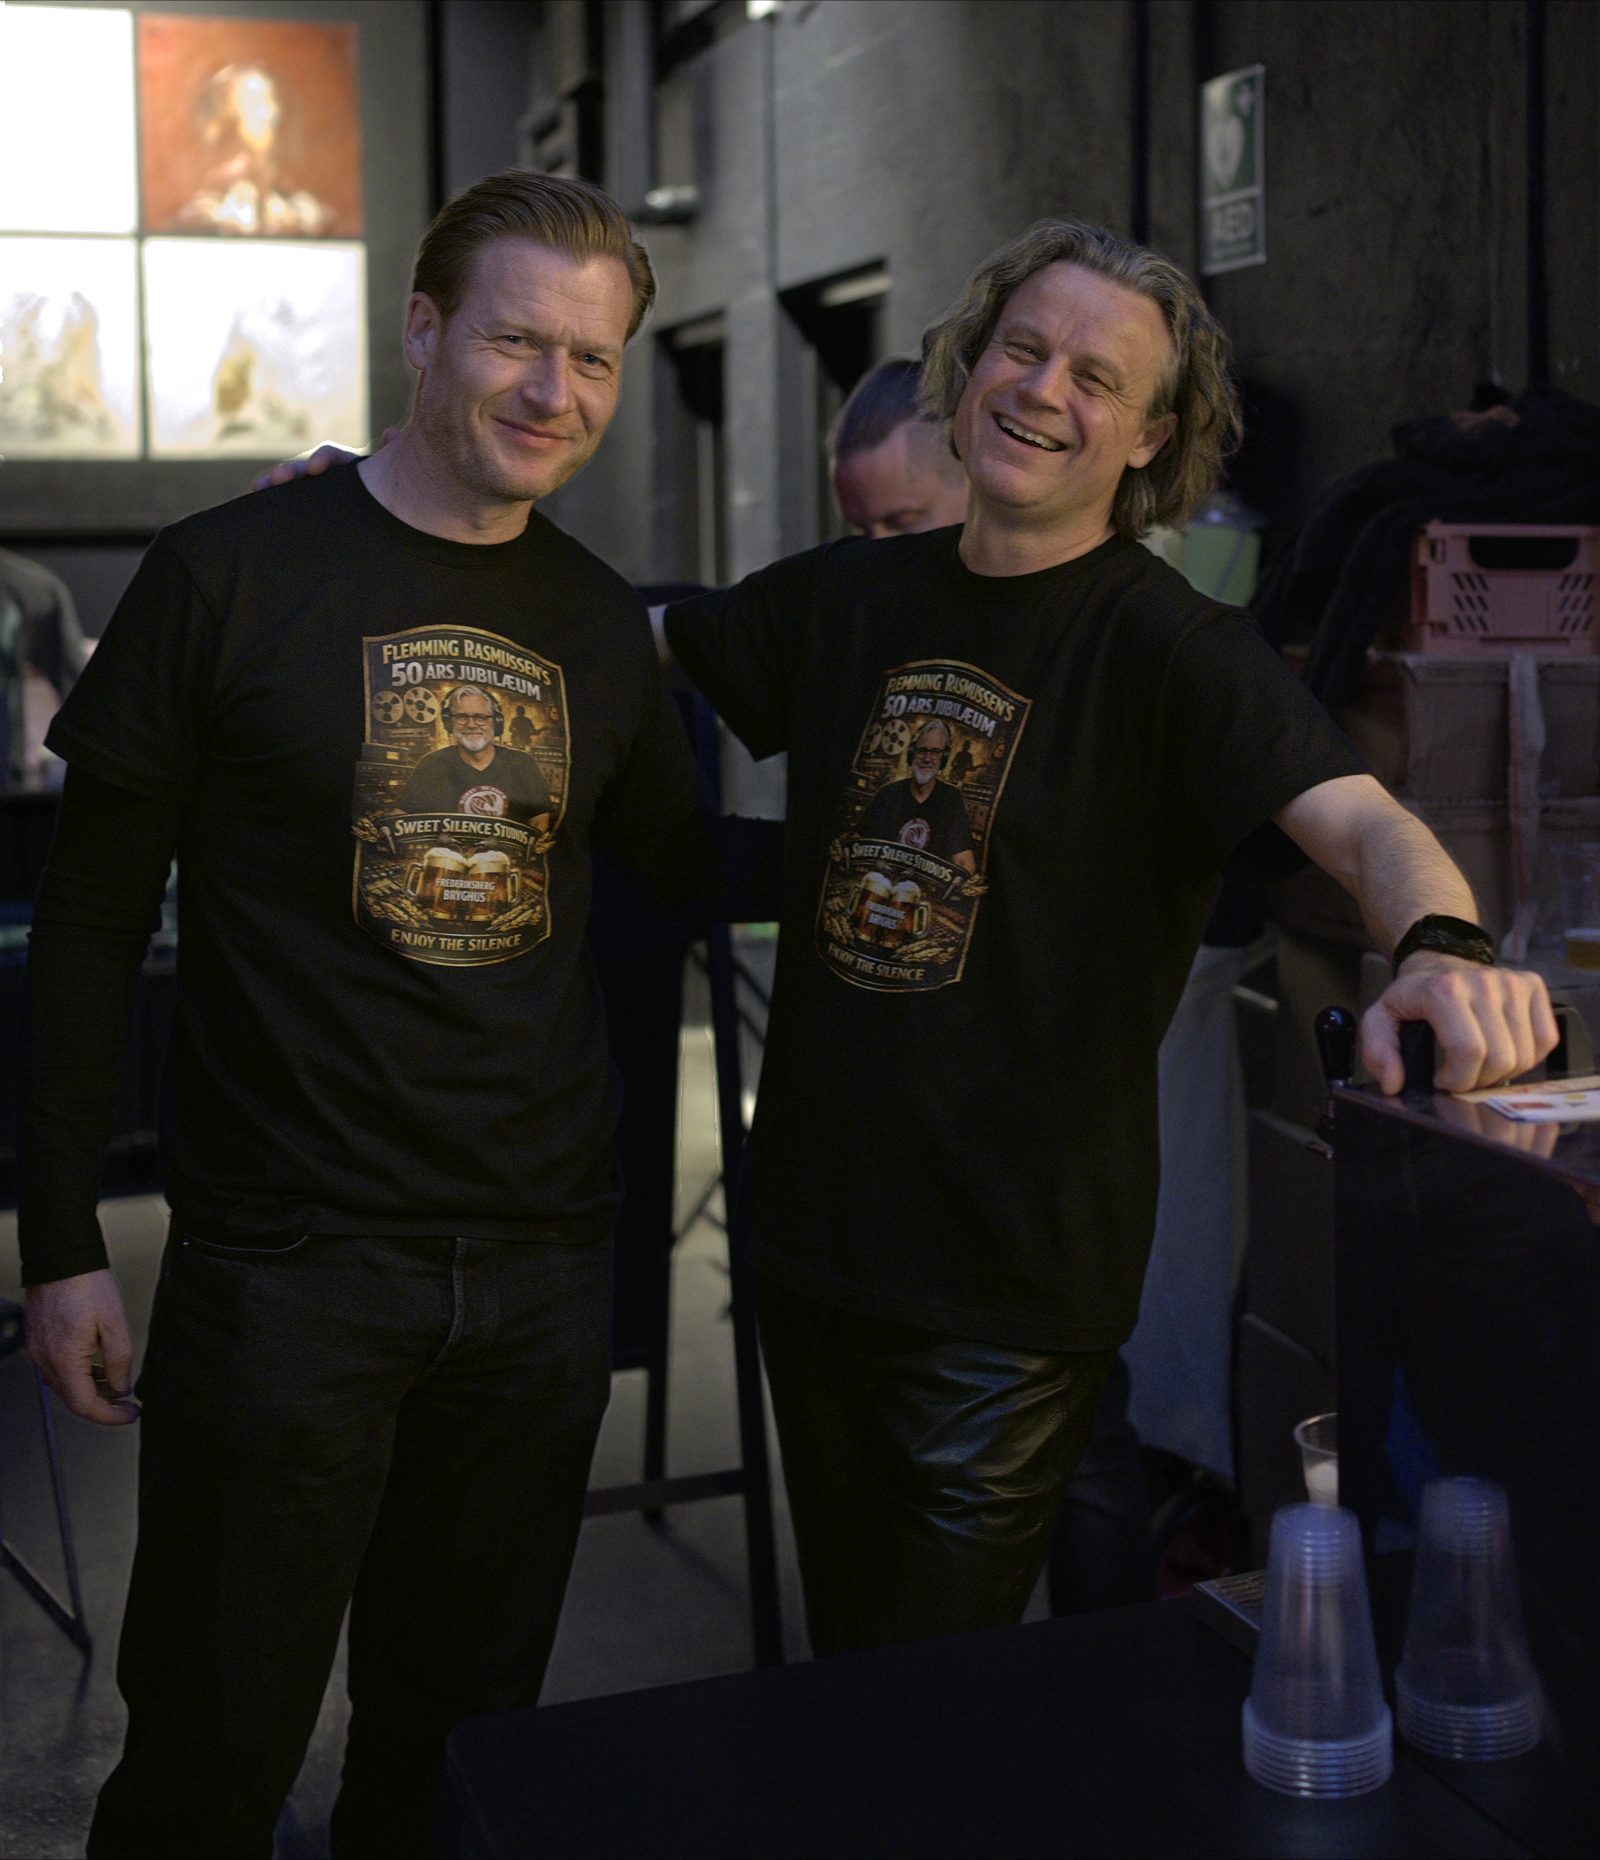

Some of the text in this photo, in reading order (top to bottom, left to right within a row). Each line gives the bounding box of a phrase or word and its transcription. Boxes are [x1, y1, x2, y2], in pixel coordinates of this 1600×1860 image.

[382, 639, 552, 686] FLEMMING RASMUSSEN'S
[391, 661, 542, 701] 50 ÅRS JUBILÆUM
[880, 694, 998, 738] 50 ÅRS JUBILÆUM
[394, 818, 529, 846] SWEET SILENCE STUDIOS
[851, 842, 882, 859] SWEET
[913, 854, 954, 883] STUDIOS
[443, 889, 487, 903] BRYGHUS
[391, 928, 523, 951] ENJOY THE SILENCE
[856, 957, 877, 976] THE
[876, 963, 926, 981] SILENCE
